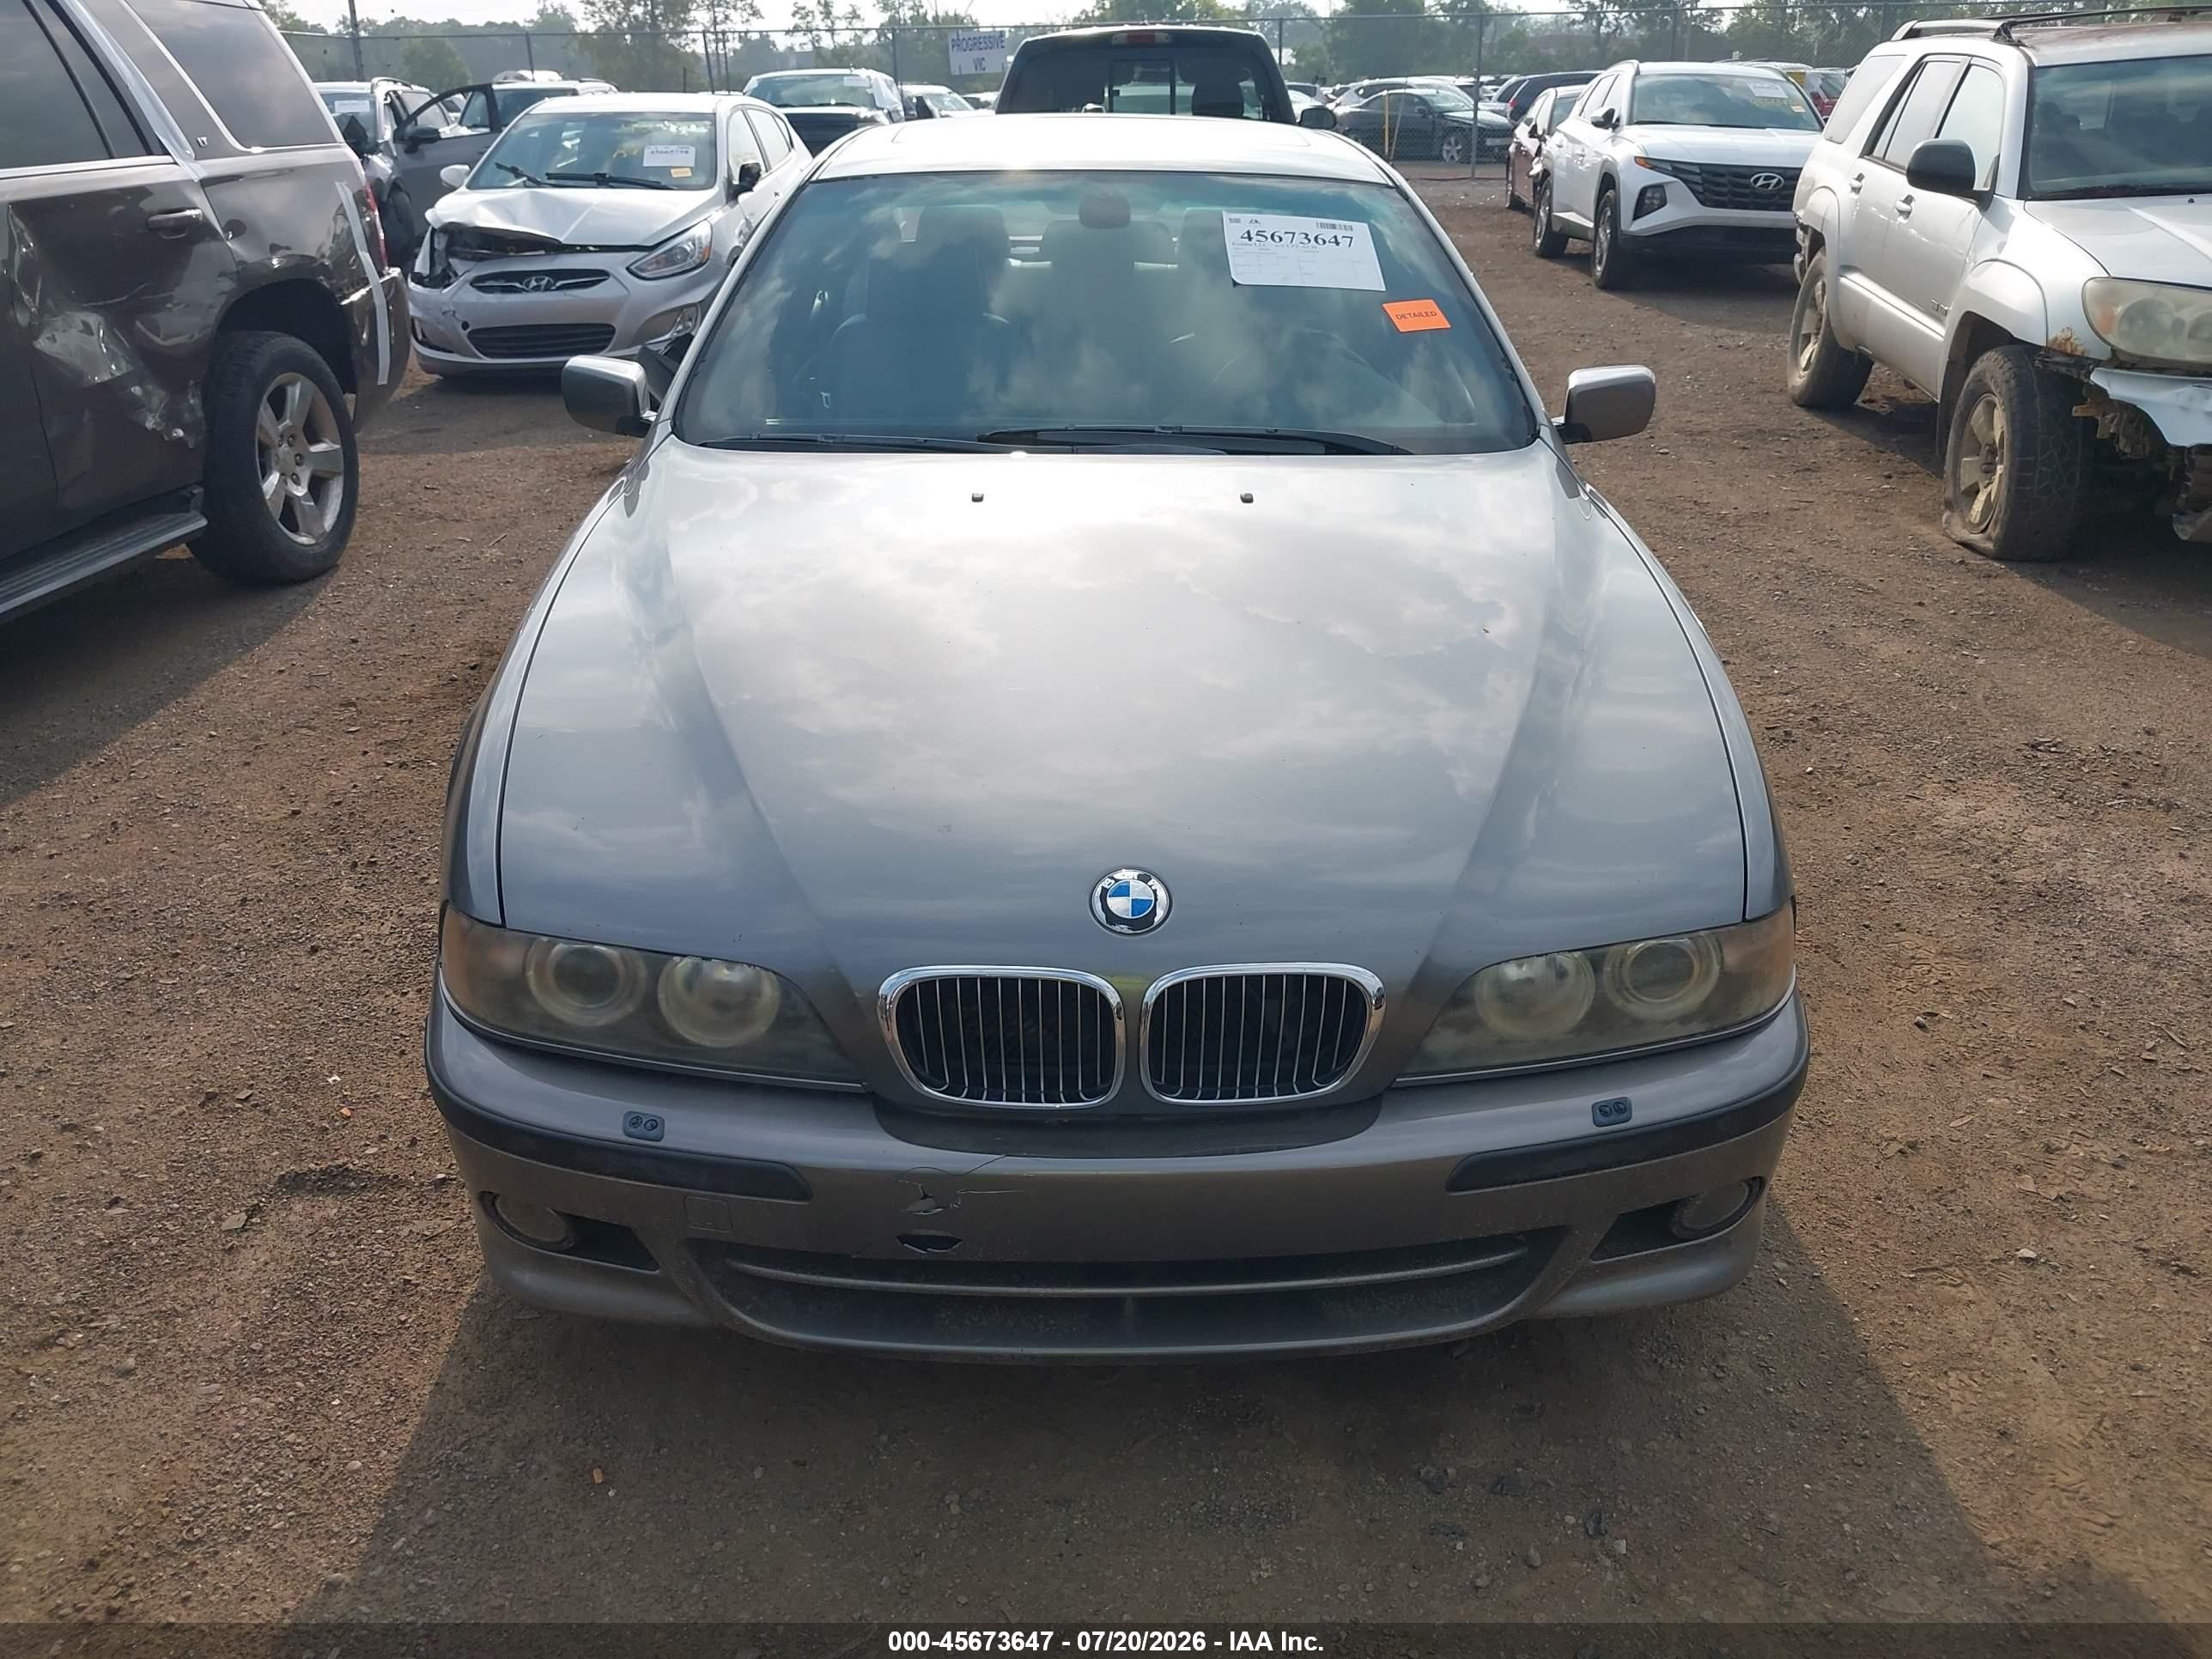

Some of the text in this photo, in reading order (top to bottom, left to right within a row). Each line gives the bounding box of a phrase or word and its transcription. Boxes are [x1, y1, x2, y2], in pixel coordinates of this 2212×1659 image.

[951, 34, 1005, 52] PROGRESSIVE
[972, 57, 987, 71] VIC
[1240, 228, 1354, 248] 45673647
[1395, 311, 1437, 320] DETAILED
